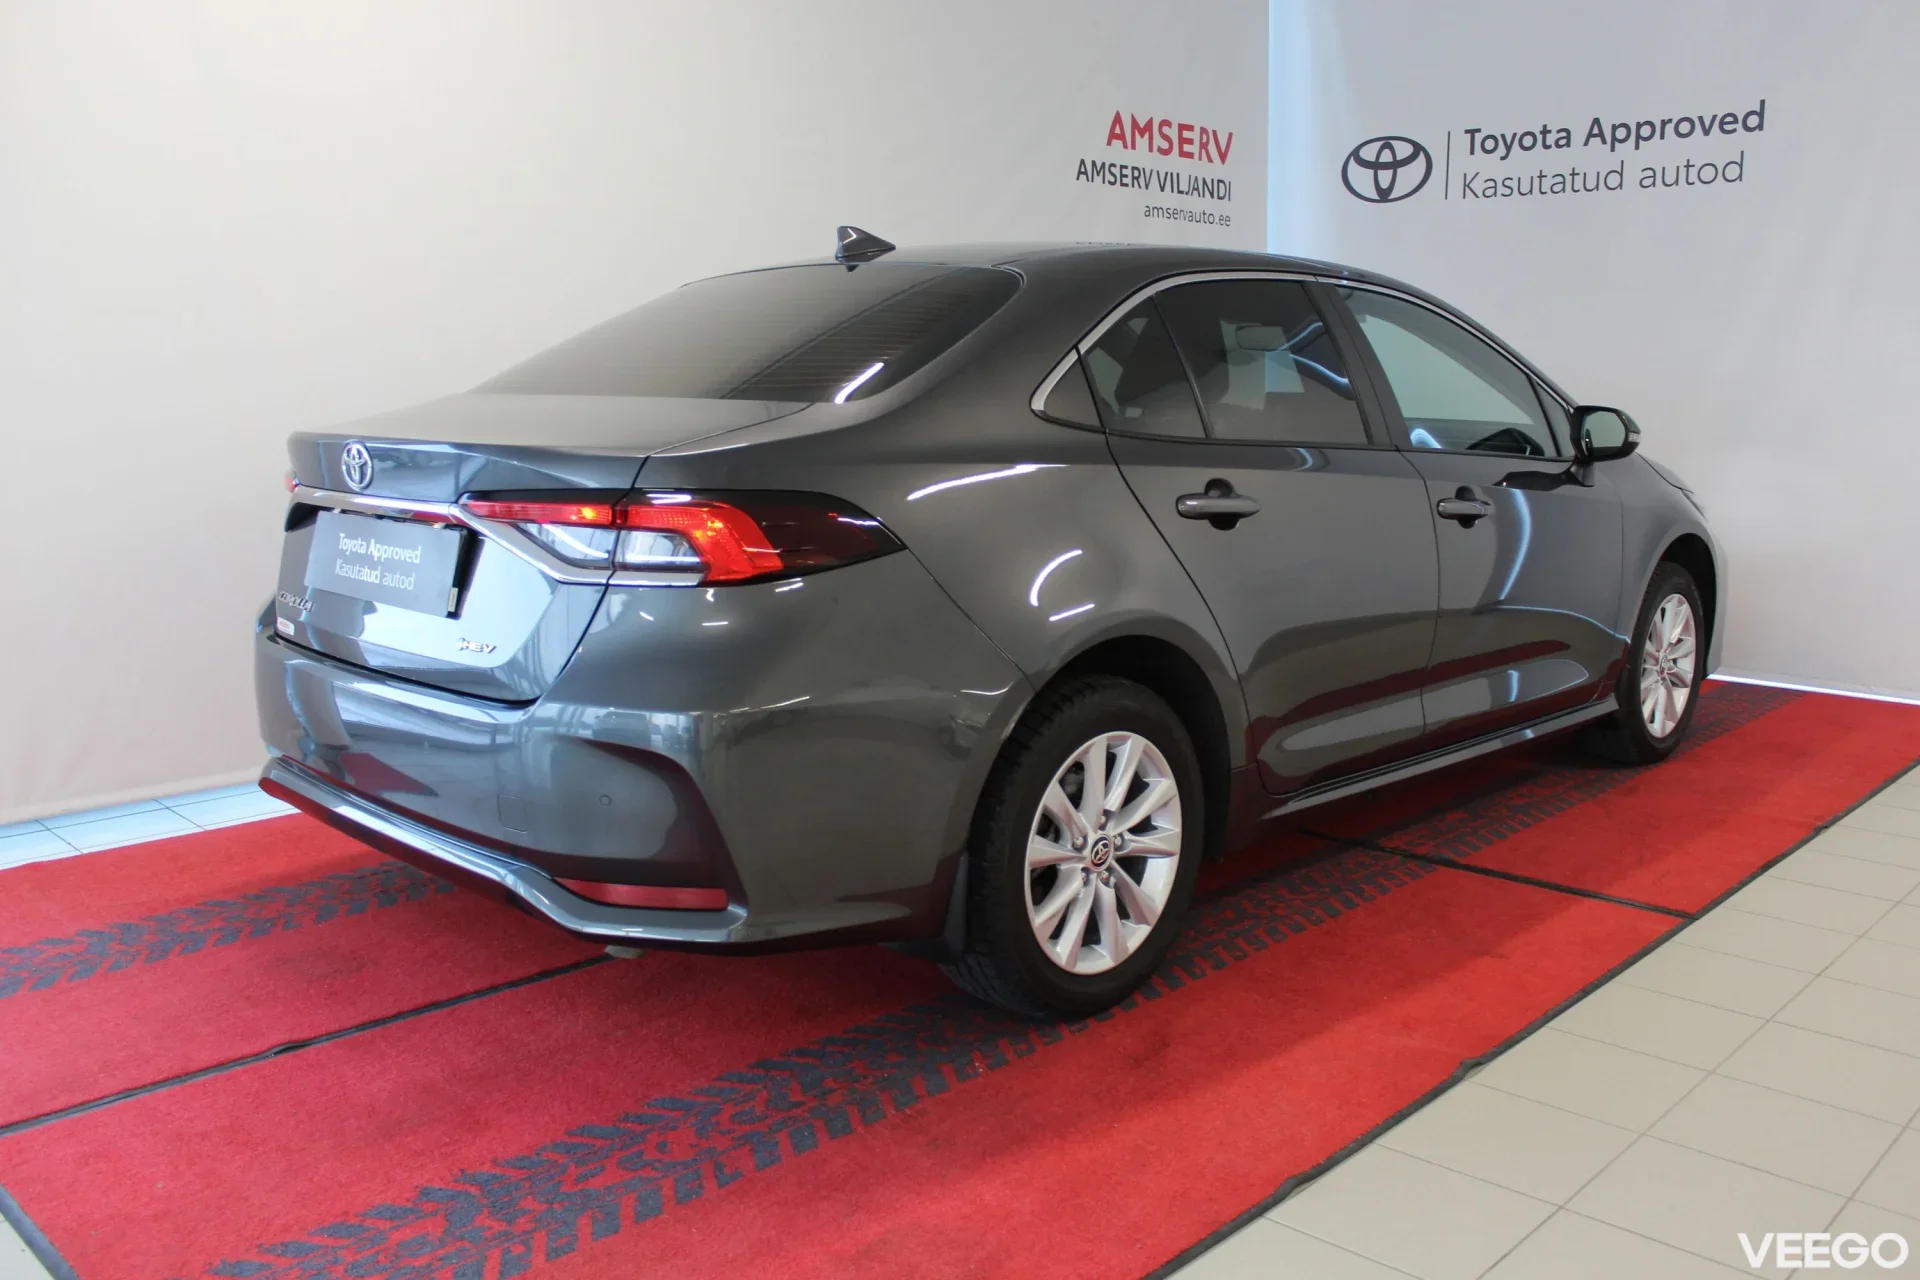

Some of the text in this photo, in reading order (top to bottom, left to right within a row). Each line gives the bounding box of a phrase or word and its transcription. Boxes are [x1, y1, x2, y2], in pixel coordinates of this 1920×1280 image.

[1106, 110, 1233, 166] AMSERV
[1464, 99, 1766, 160] Toyota Approved
[1076, 158, 1231, 202] AMSERV VILJANDI
[1462, 150, 1744, 199] Kasutatud autod
[1144, 205, 1231, 227] amservauto.ee
[339, 532, 422, 564] Toyota Approved
[335, 558, 415, 590] Kasutatud autod
